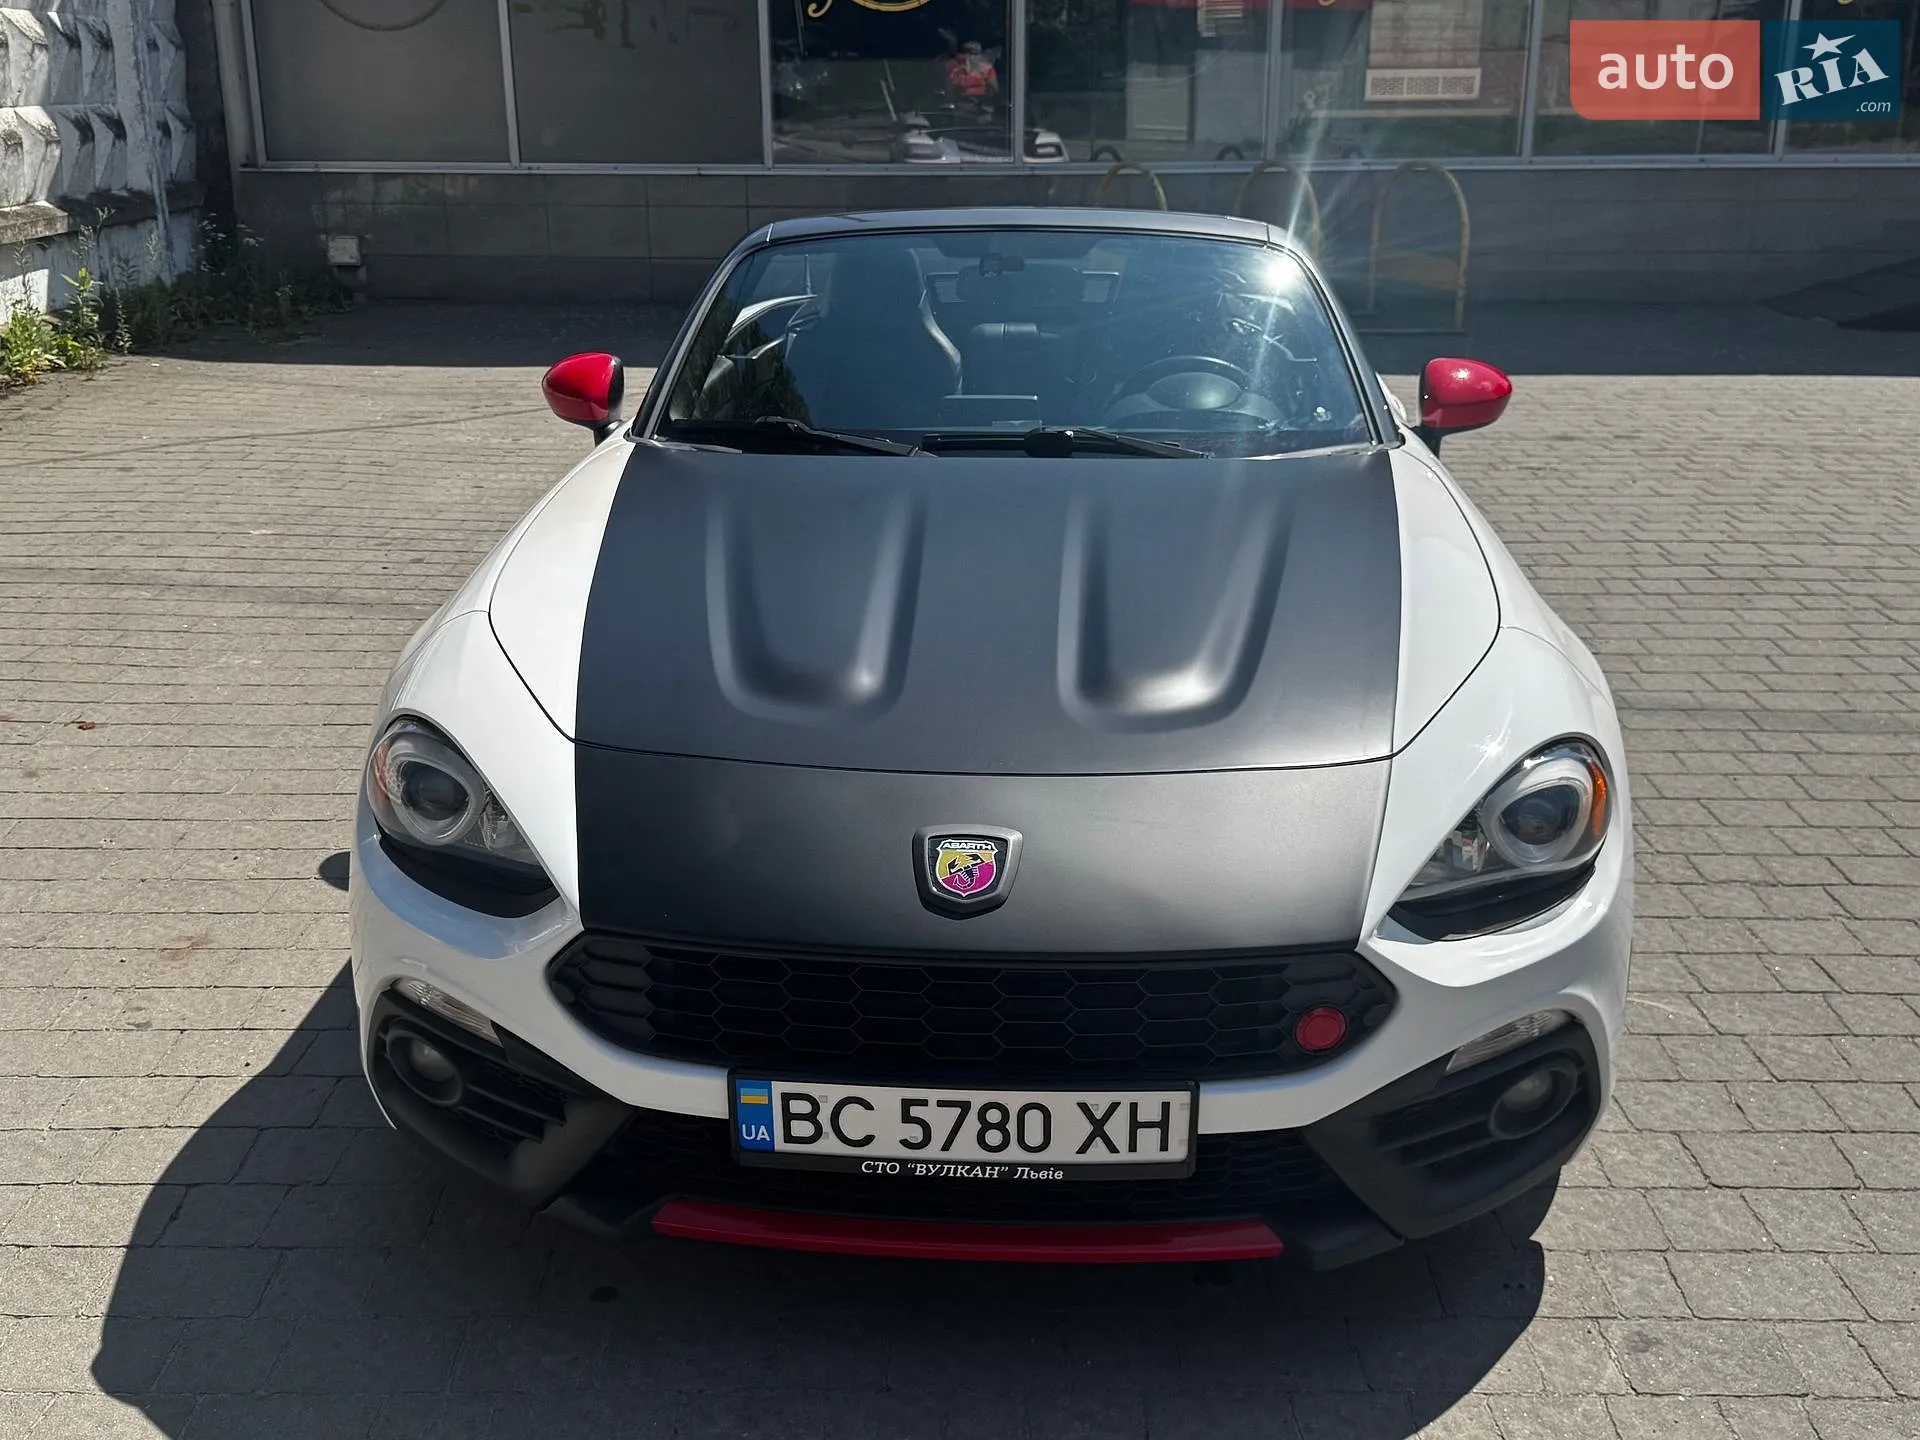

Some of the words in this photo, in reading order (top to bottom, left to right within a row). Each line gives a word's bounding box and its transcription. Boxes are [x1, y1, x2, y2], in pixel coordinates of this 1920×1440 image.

[942, 842, 992, 850] ABARTH
[780, 1091, 876, 1148] BC
[899, 1098, 1052, 1153] 5780
[1075, 1101, 1171, 1154] XH
[741, 1123, 771, 1142] UA
[861, 1160, 901, 1175] СТО
[1013, 1167, 1064, 1180] Львів
